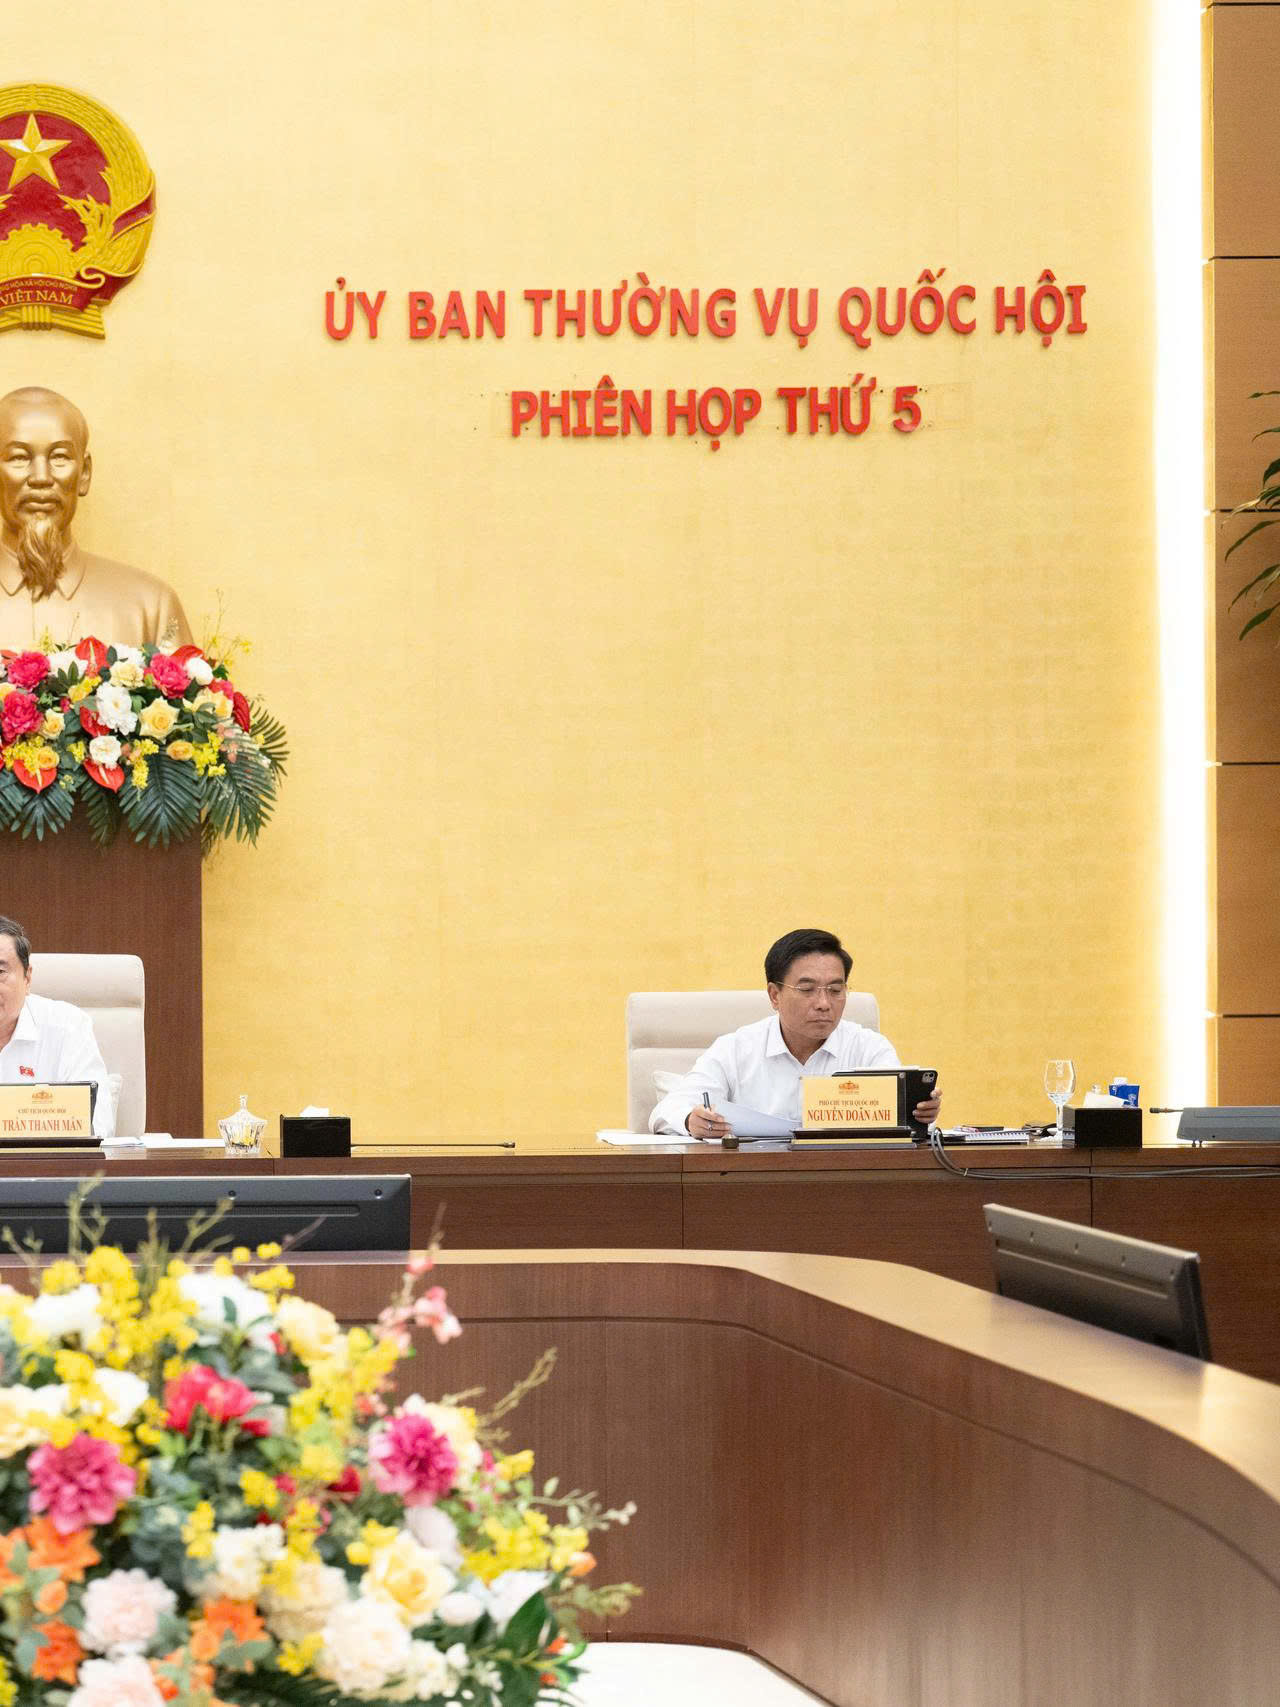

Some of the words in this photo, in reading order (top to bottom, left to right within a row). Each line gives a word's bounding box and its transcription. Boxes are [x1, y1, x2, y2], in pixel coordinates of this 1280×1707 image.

[36, 289, 74, 305] NAM
[324, 277, 388, 341] ỦY
[408, 290, 507, 341] BAN
[523, 271, 738, 339] THƯỜNG
[753, 287, 820, 350] VỤ
[837, 267, 978, 350] QUỐC
[994, 268, 1089, 349] HỘI
[510, 374, 653, 439] PHIÊN
[666, 386, 763, 452] HỌP
[775, 372, 878, 437] THỨ
[892, 385, 923, 435] 5
[872, 1109, 891, 1121] ANH
[28, 1119, 60, 1131] THANH
